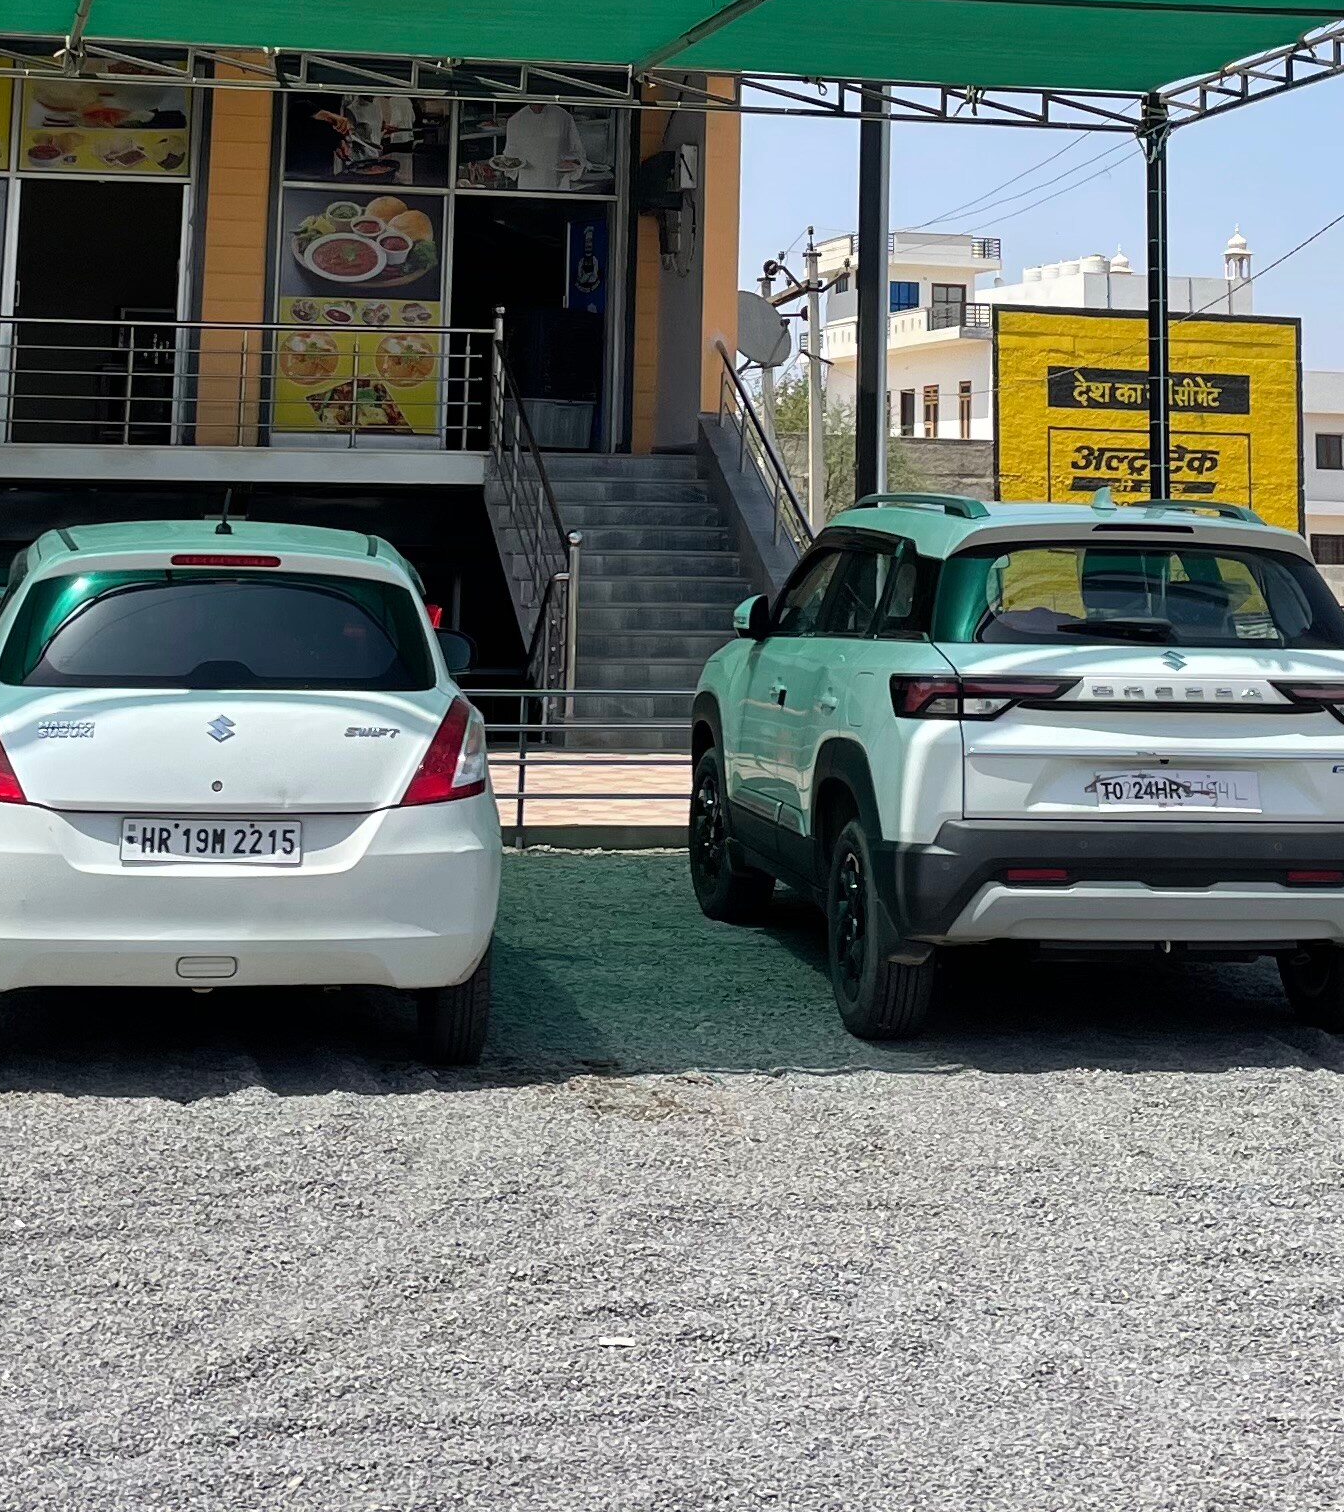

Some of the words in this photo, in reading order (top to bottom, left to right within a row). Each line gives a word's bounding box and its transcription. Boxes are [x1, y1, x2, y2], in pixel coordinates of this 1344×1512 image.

[1072, 370, 1112, 407] देश
[1114, 382, 1144, 404] का
[1070, 443, 1220, 477] अल्ट्रटेक
[344, 726, 401, 739] SWIFT
